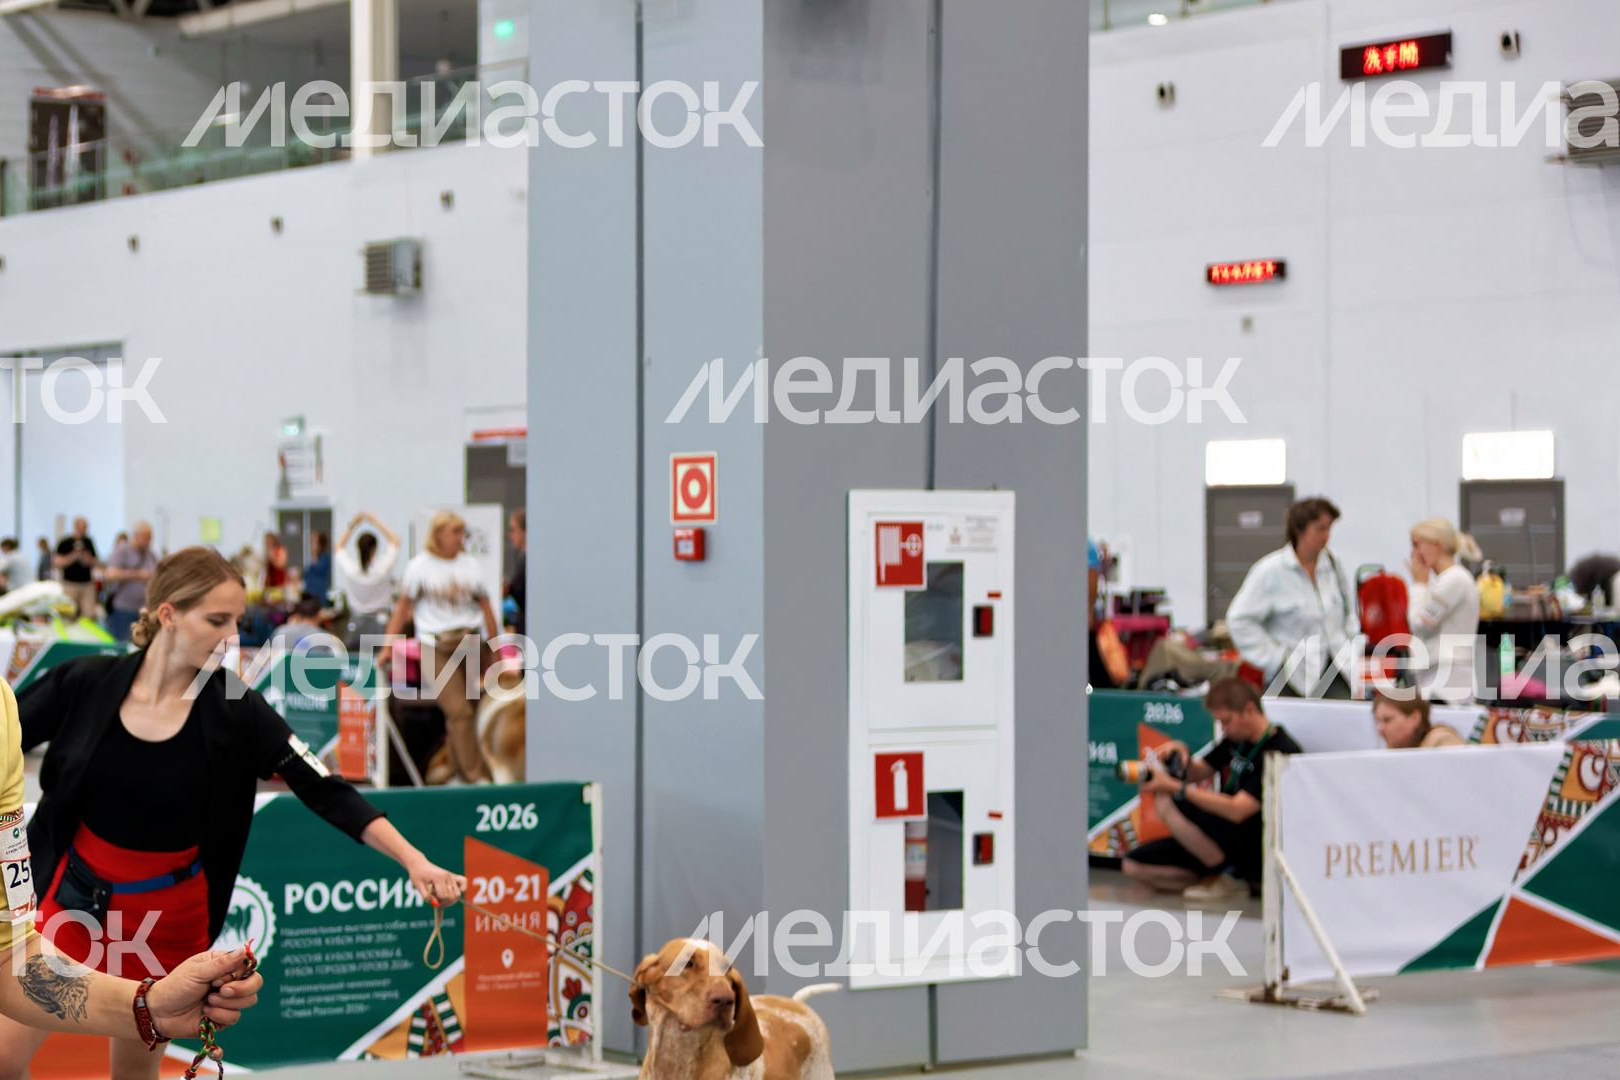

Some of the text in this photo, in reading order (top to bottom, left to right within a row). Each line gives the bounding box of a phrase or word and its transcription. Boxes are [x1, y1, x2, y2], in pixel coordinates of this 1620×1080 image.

[475, 802, 539, 832] 2026
[1324, 835, 1476, 880] PREMIER
[285, 877, 424, 916] РОССИЯ
[472, 873, 541, 904] 20-21
[475, 911, 541, 933] ИЮНЯ
